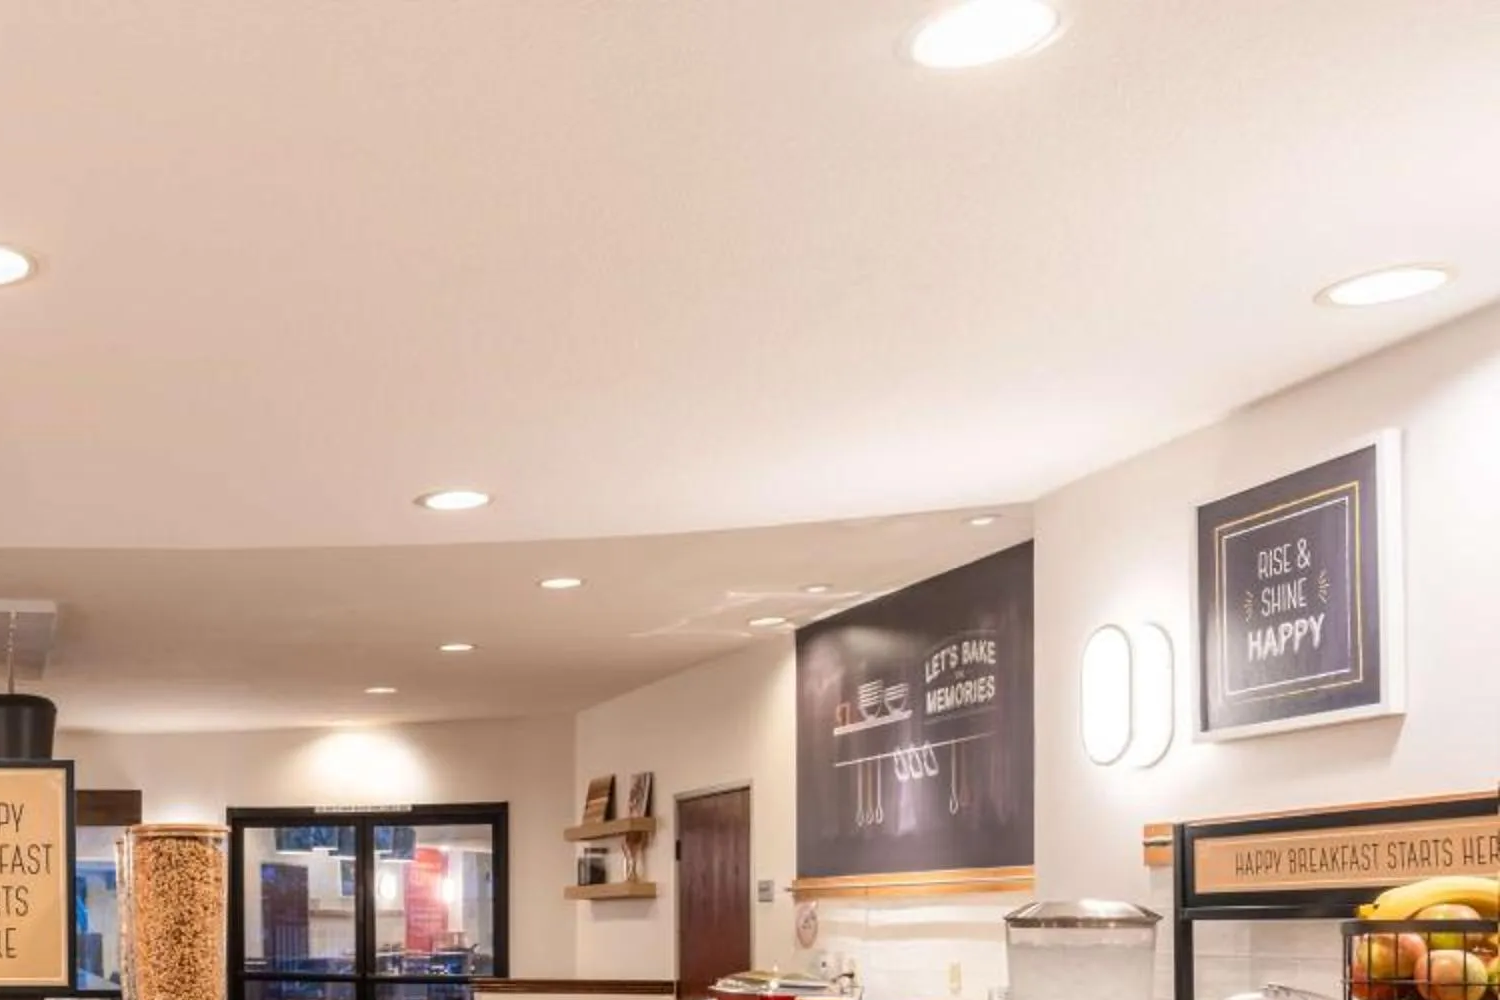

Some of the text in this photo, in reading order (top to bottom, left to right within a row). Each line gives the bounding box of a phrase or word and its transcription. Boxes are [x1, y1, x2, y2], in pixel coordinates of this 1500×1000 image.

[1258, 538, 1311, 579] RISE &
[1261, 577, 1308, 617] SHINE
[1248, 612, 1325, 662] HAPPY
[925, 640, 997, 684] LET'S BAKE
[926, 675, 995, 715] MEMORIES
[1235, 851, 1282, 876] HAPPY
[1288, 843, 1380, 874] BREAKFAST
[1387, 839, 1453, 870] STARTS
